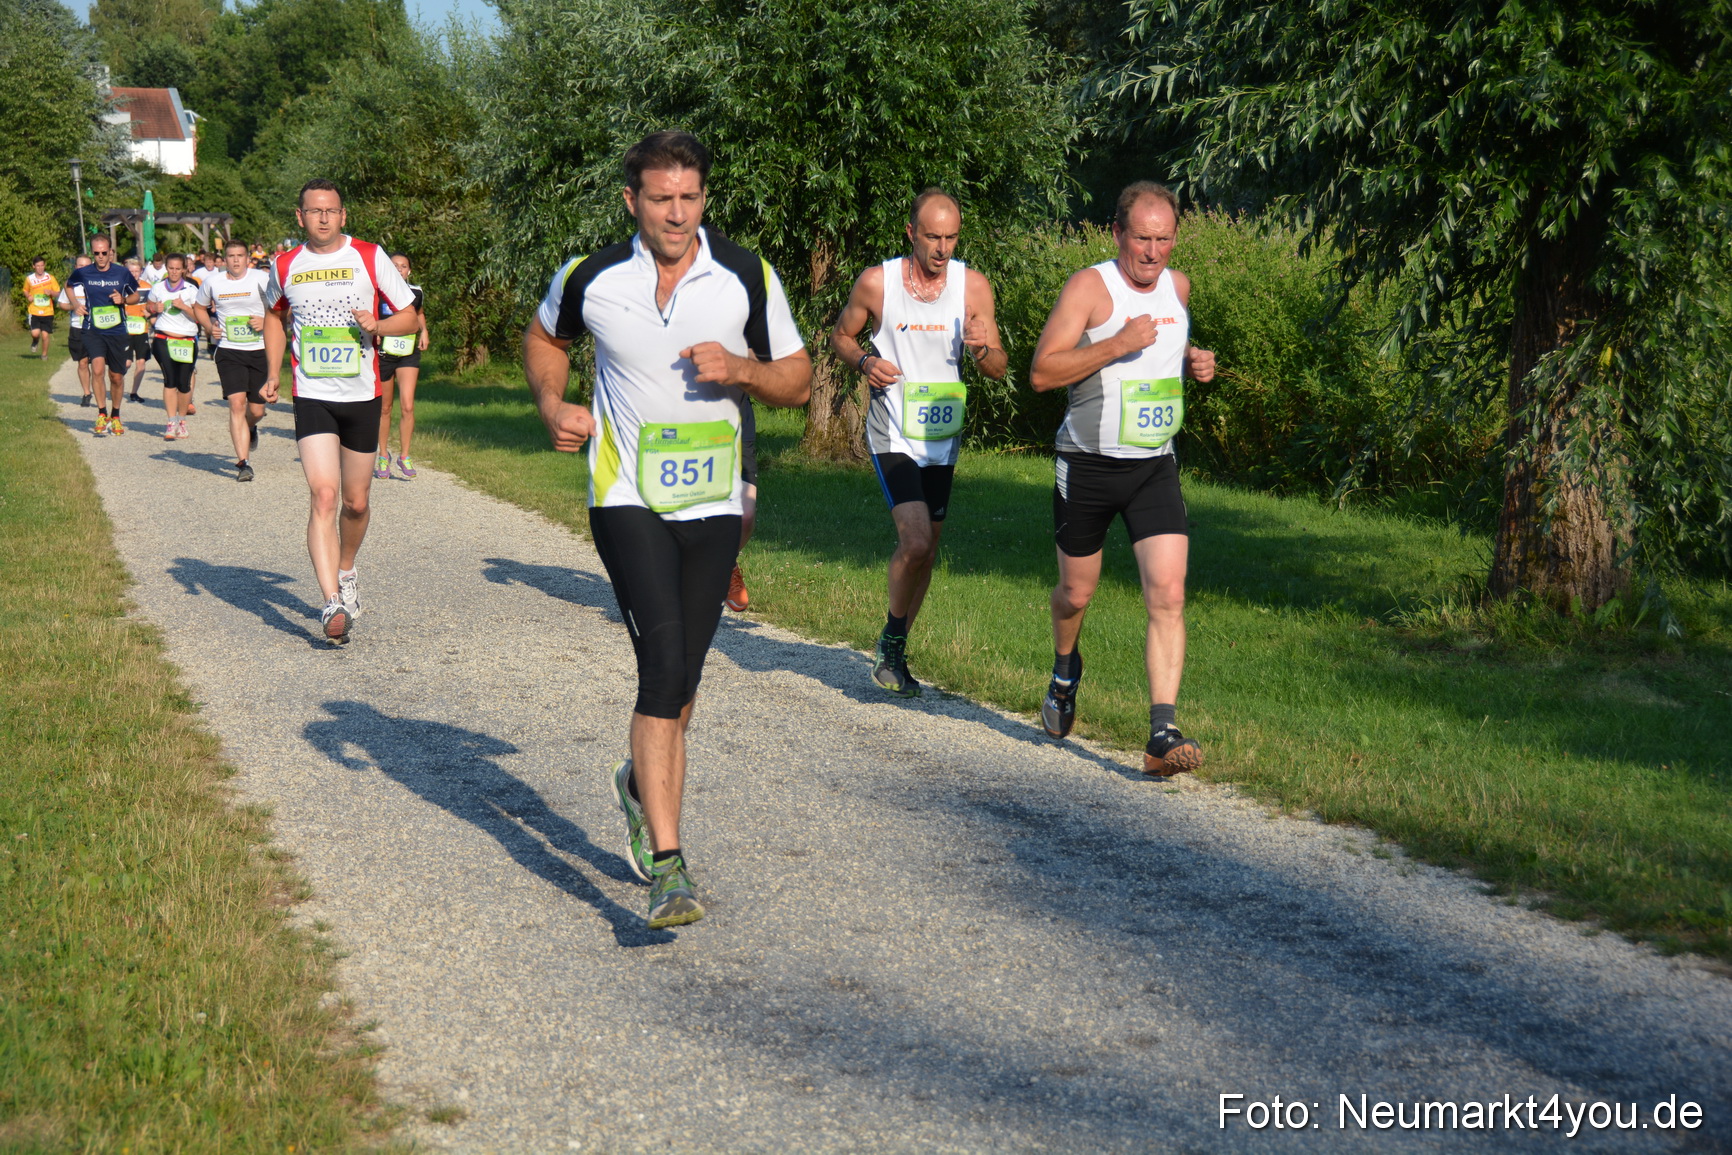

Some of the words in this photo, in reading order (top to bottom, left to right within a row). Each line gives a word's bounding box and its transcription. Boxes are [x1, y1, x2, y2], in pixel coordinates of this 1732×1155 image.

[294, 270, 348, 283] ONLINE
[99, 314, 116, 324] 365
[1154, 317, 1178, 326] EBL
[233, 326, 253, 336] 532
[909, 324, 949, 332] KLEBL
[393, 339, 406, 350] 36
[173, 347, 188, 357] 118
[308, 347, 354, 363] 1027
[916, 405, 953, 424] 588
[1136, 405, 1174, 428] 583
[660, 456, 714, 487] 851
